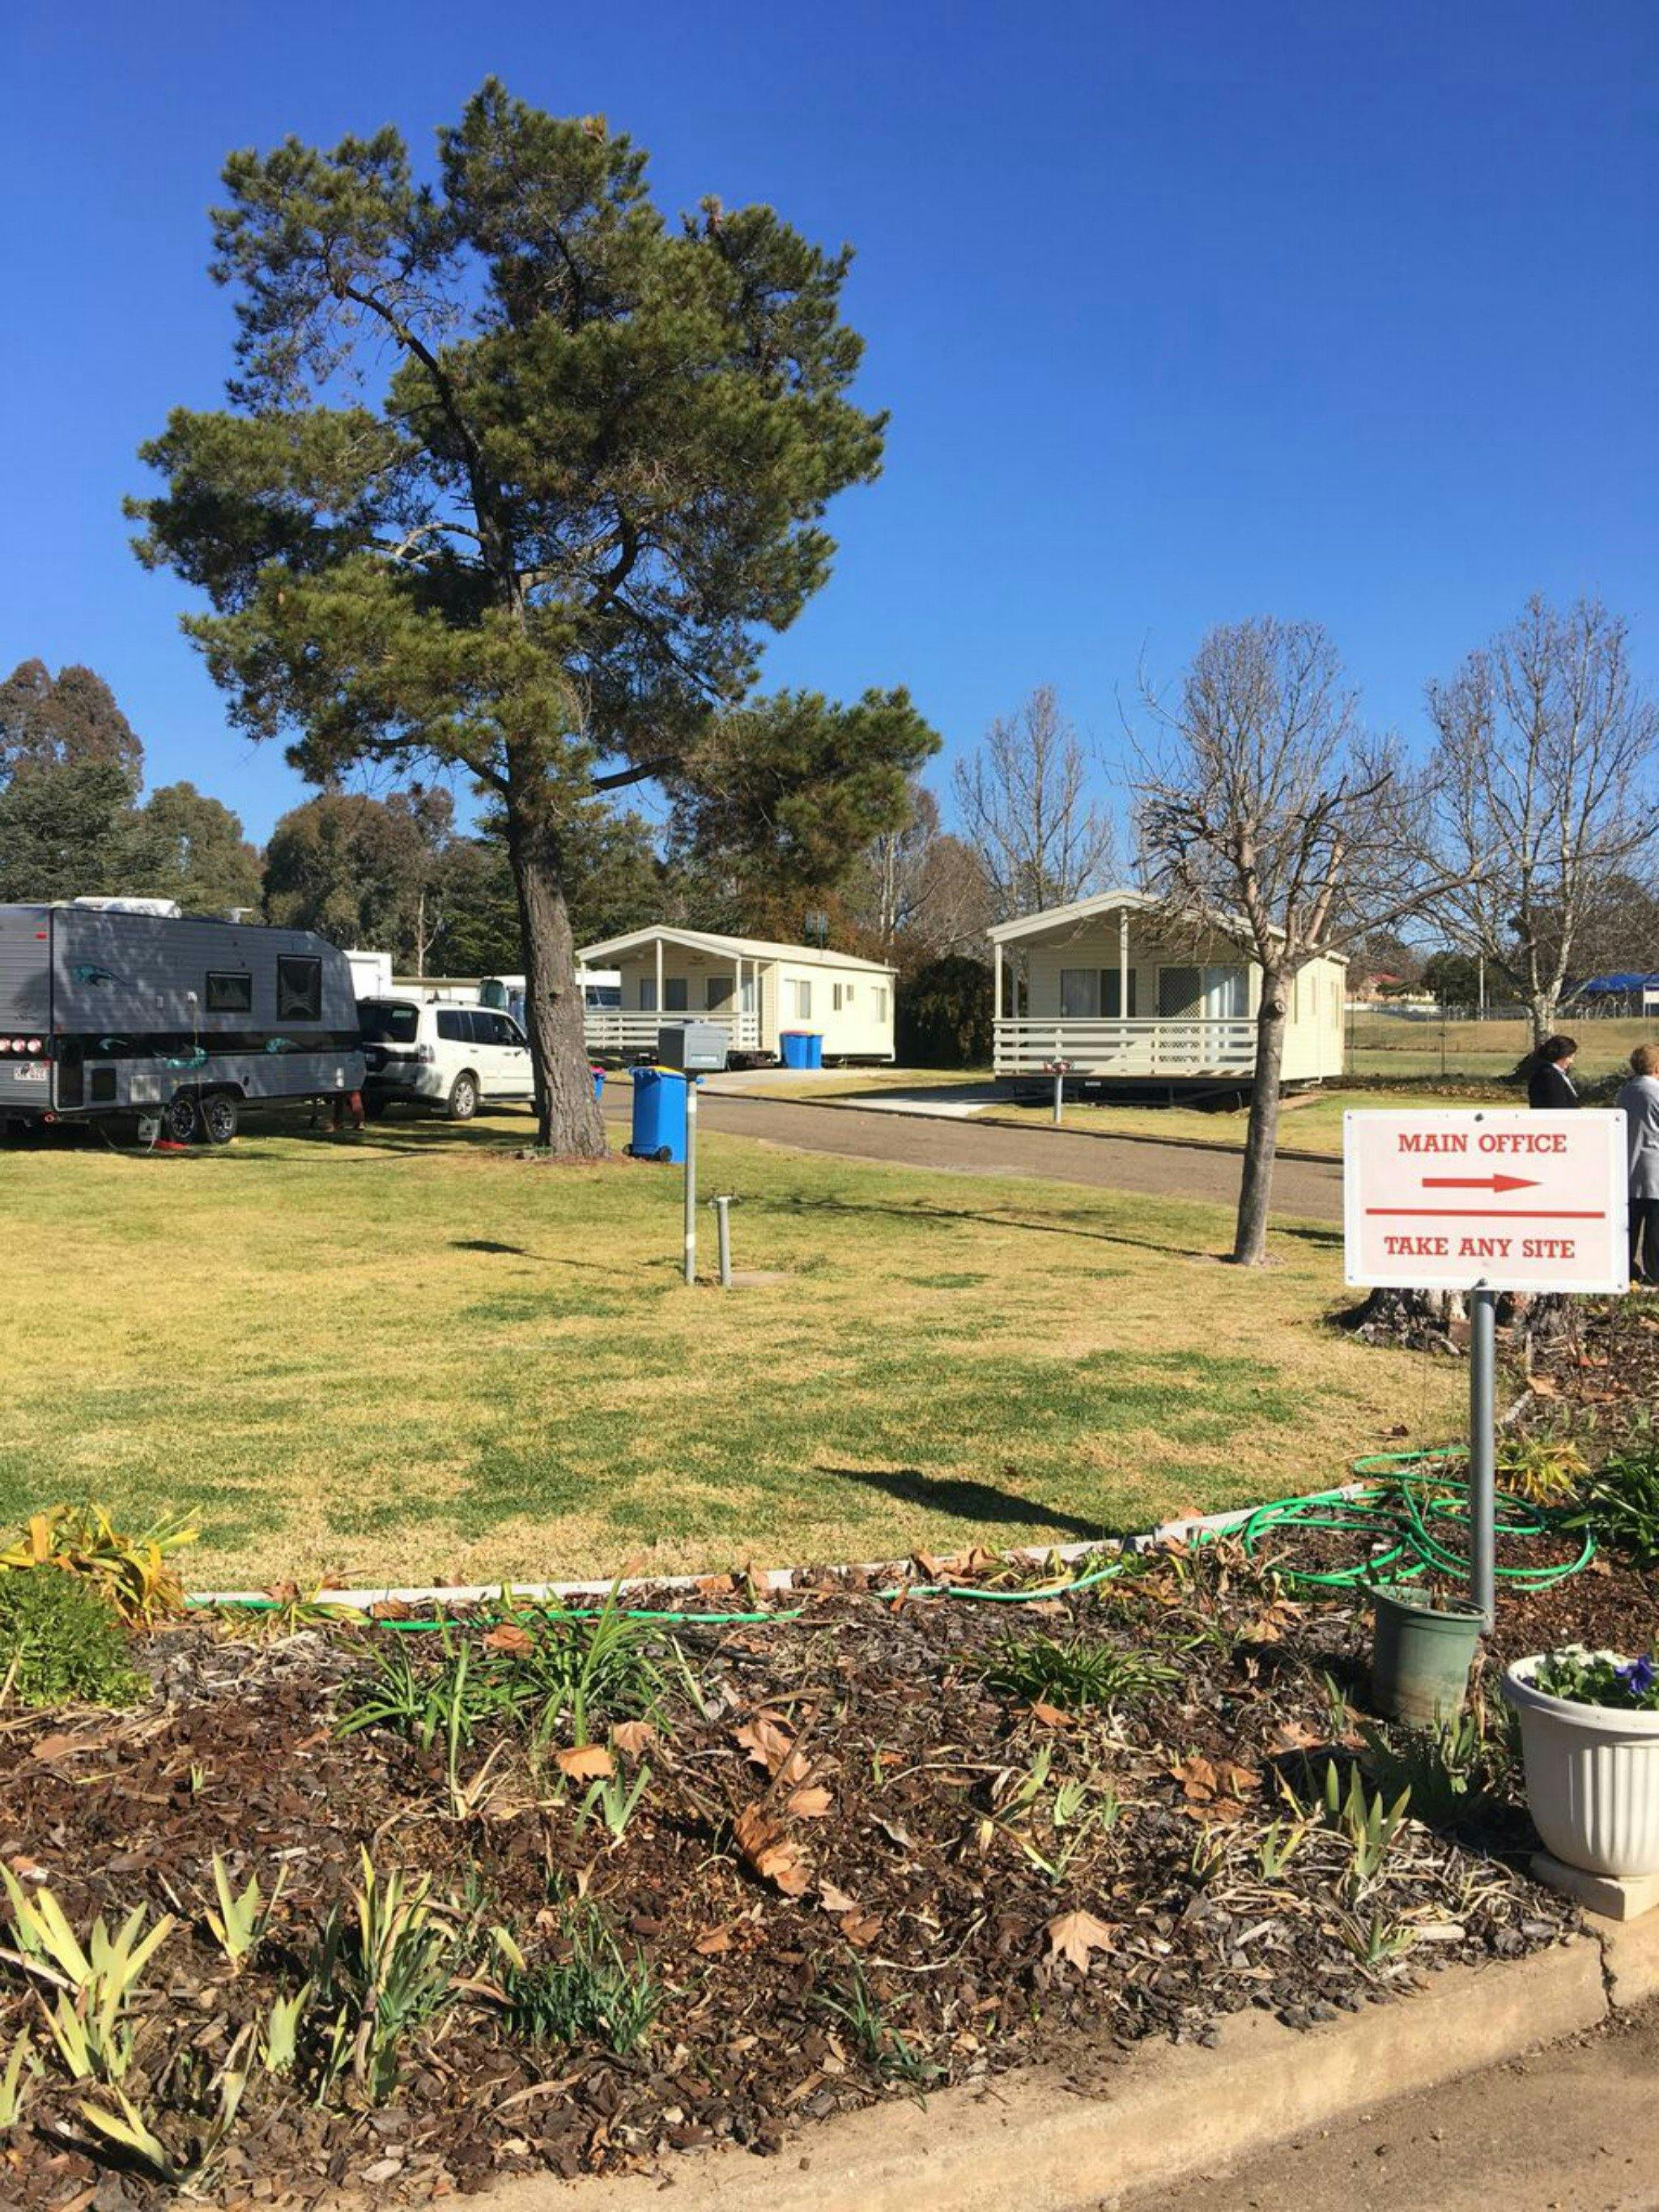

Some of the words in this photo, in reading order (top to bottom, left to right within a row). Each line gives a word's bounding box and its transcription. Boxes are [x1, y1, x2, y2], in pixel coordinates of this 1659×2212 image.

[1397, 1134, 1468, 1153] MAIN
[1478, 1134, 1567, 1154] OFFICE
[1384, 1236, 1448, 1257] TAKE
[1458, 1238, 1512, 1257] ANY
[1522, 1240, 1576, 1259] SITE
